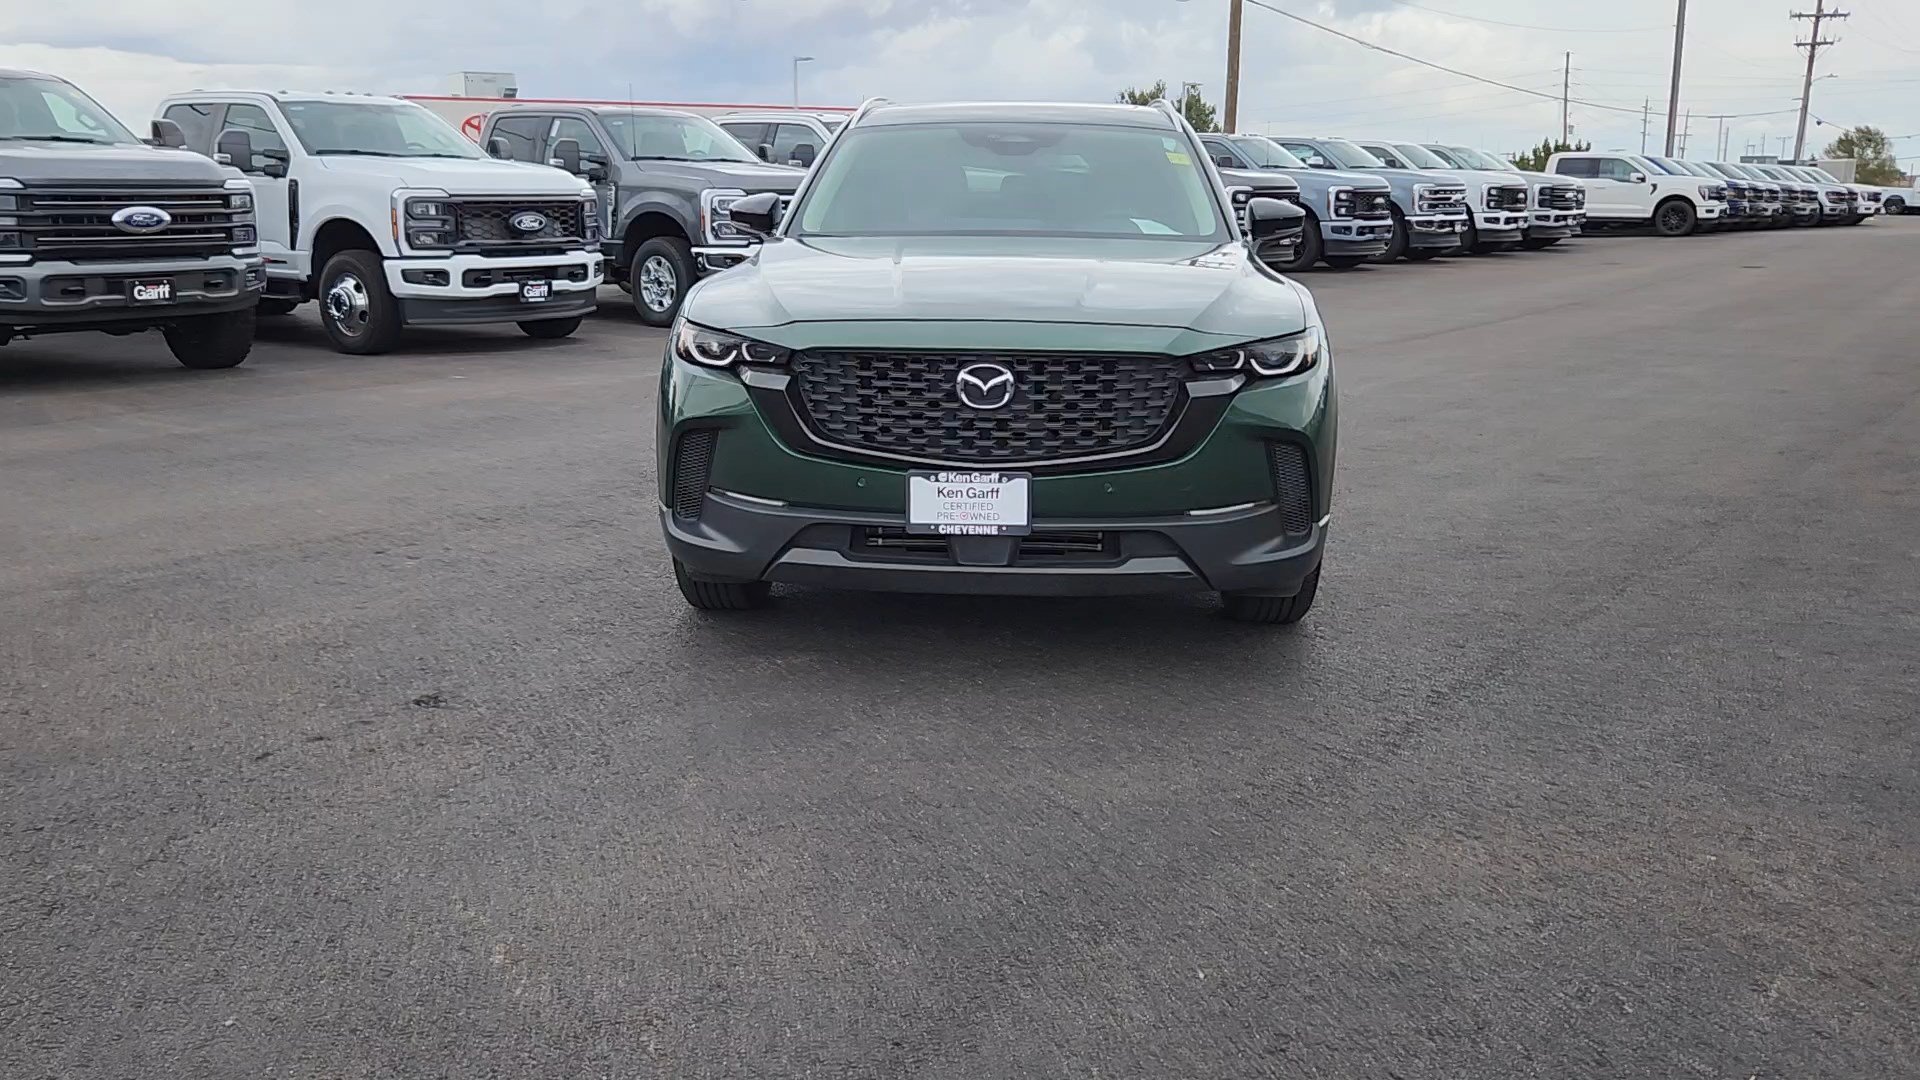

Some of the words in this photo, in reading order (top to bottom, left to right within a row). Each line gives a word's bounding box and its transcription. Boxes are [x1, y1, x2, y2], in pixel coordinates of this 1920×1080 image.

[133, 285, 171, 300] Garff
[523, 285, 548, 298] Garff
[948, 472, 970, 482] Ken
[971, 472, 1000, 483] Garff
[937, 486, 963, 498] Ken
[966, 487, 1000, 499] Garff
[942, 502, 994, 511] CERTIFIED
[938, 525, 999, 535] CHEYENNE
